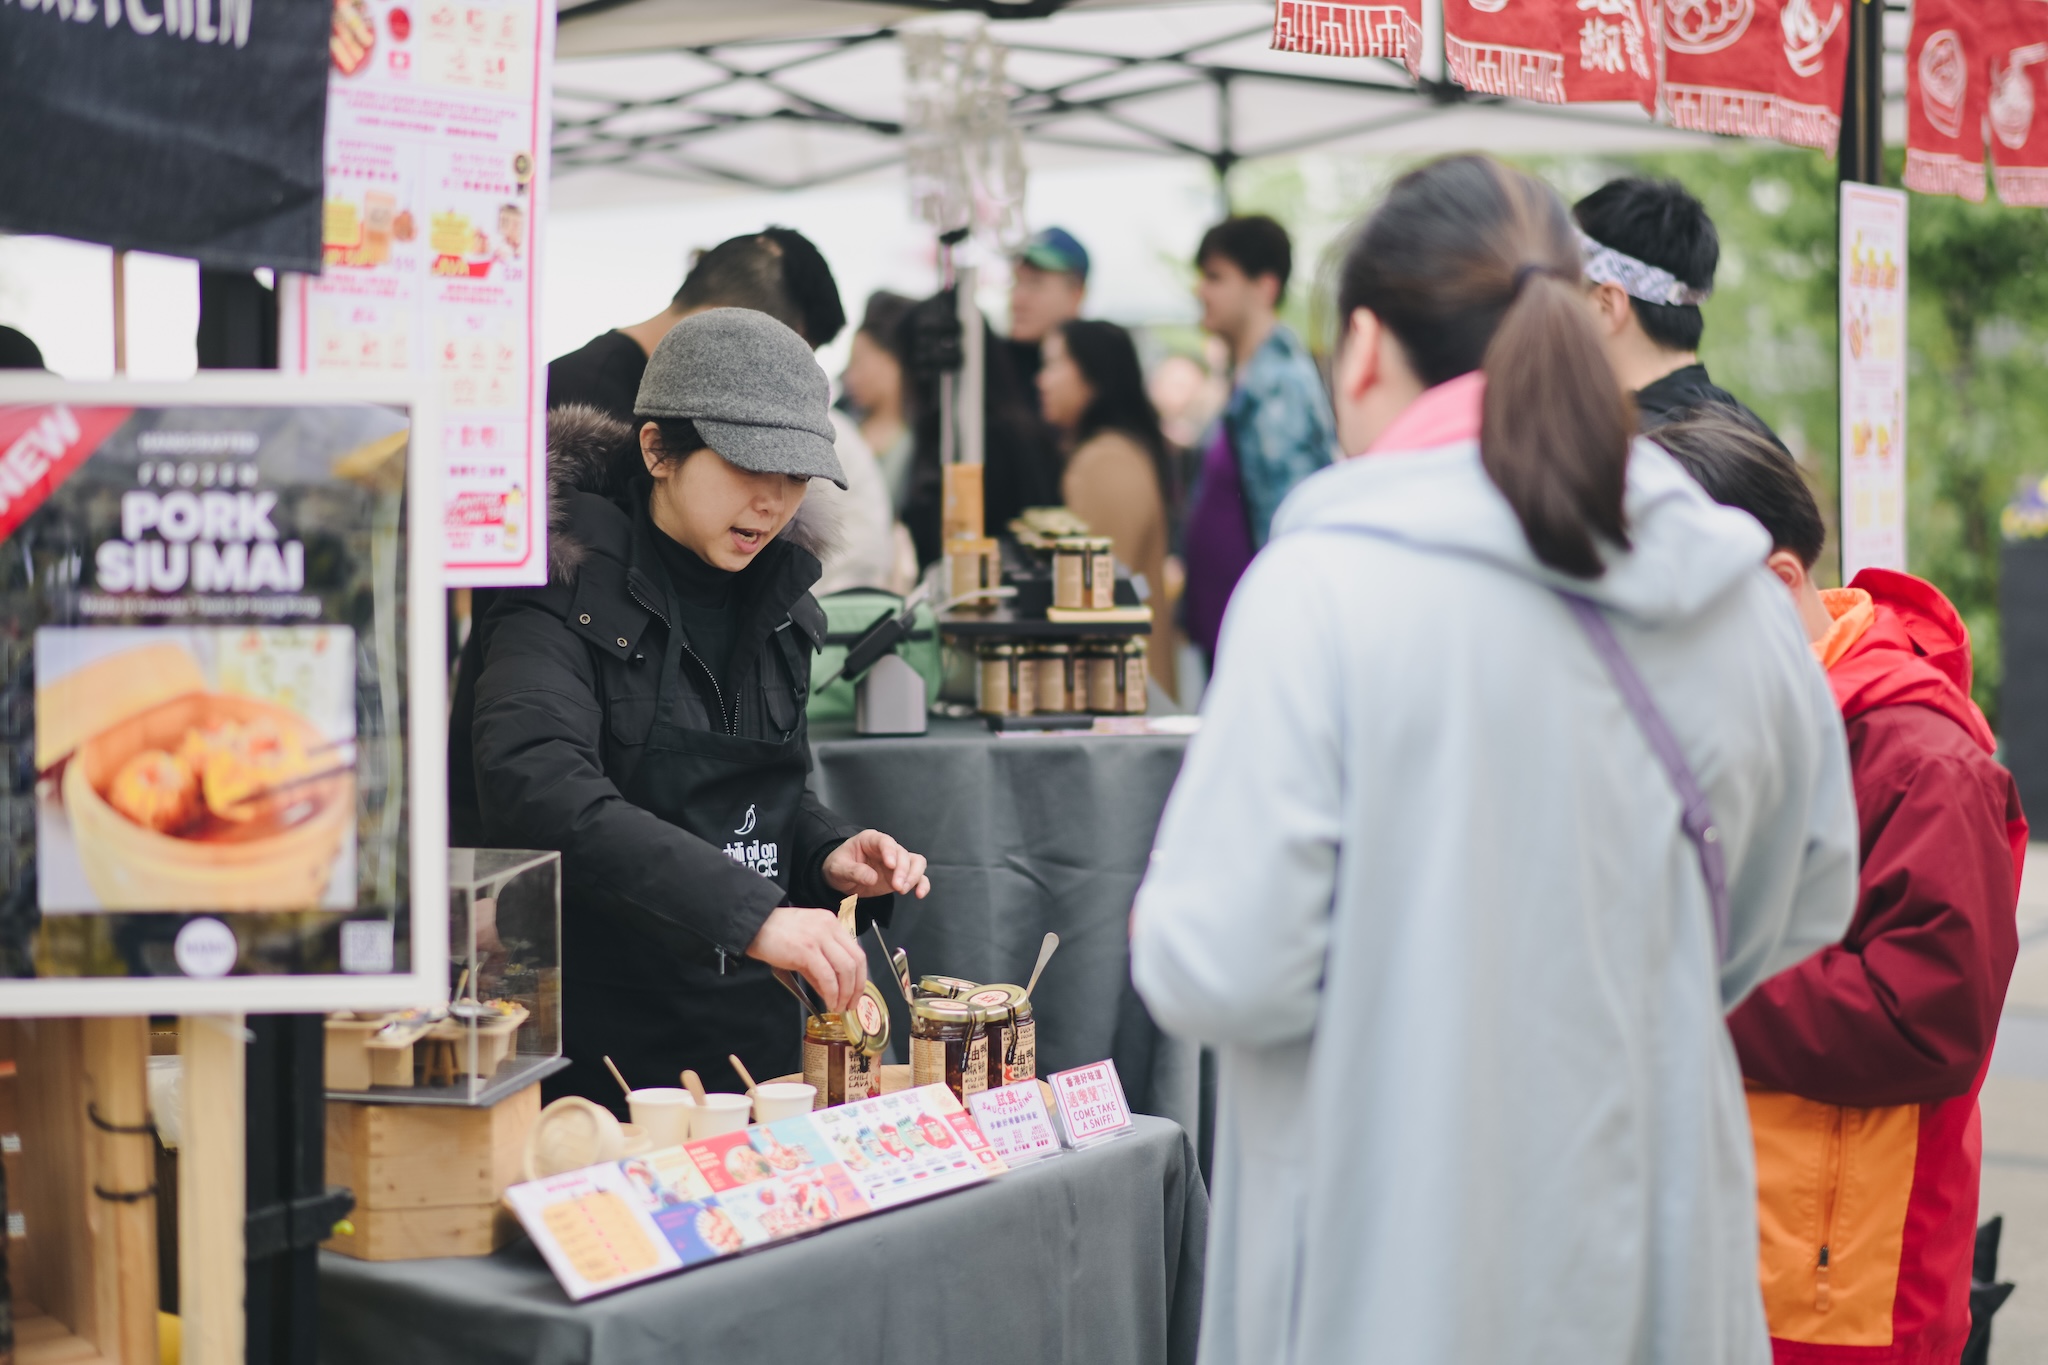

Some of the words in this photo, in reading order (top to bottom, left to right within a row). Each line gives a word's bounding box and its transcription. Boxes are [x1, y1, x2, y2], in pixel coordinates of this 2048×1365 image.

[137, 461, 259, 487] FROZEN
[121, 490, 279, 543] PORK
[95, 540, 190, 592] SIU
[191, 540, 304, 592] MAI
[746, 840, 760, 861] oil
[761, 843, 777, 859] on
[863, 1001, 875, 1030] LAVA
[849, 1081, 869, 1089] LAVA
[1065, 1069, 1104, 1088] 香港好味道
[982, 1101, 1007, 1116] SAUCE
[1009, 1091, 1033, 1114] PAIRING
[995, 1089, 1019, 1107] 試食!
[1073, 1108, 1096, 1122] COME
[1097, 1101, 1117, 1116] TAKE
[1083, 1121, 1089, 1131] A
[1089, 1116, 1115, 1130] SNIFF!
